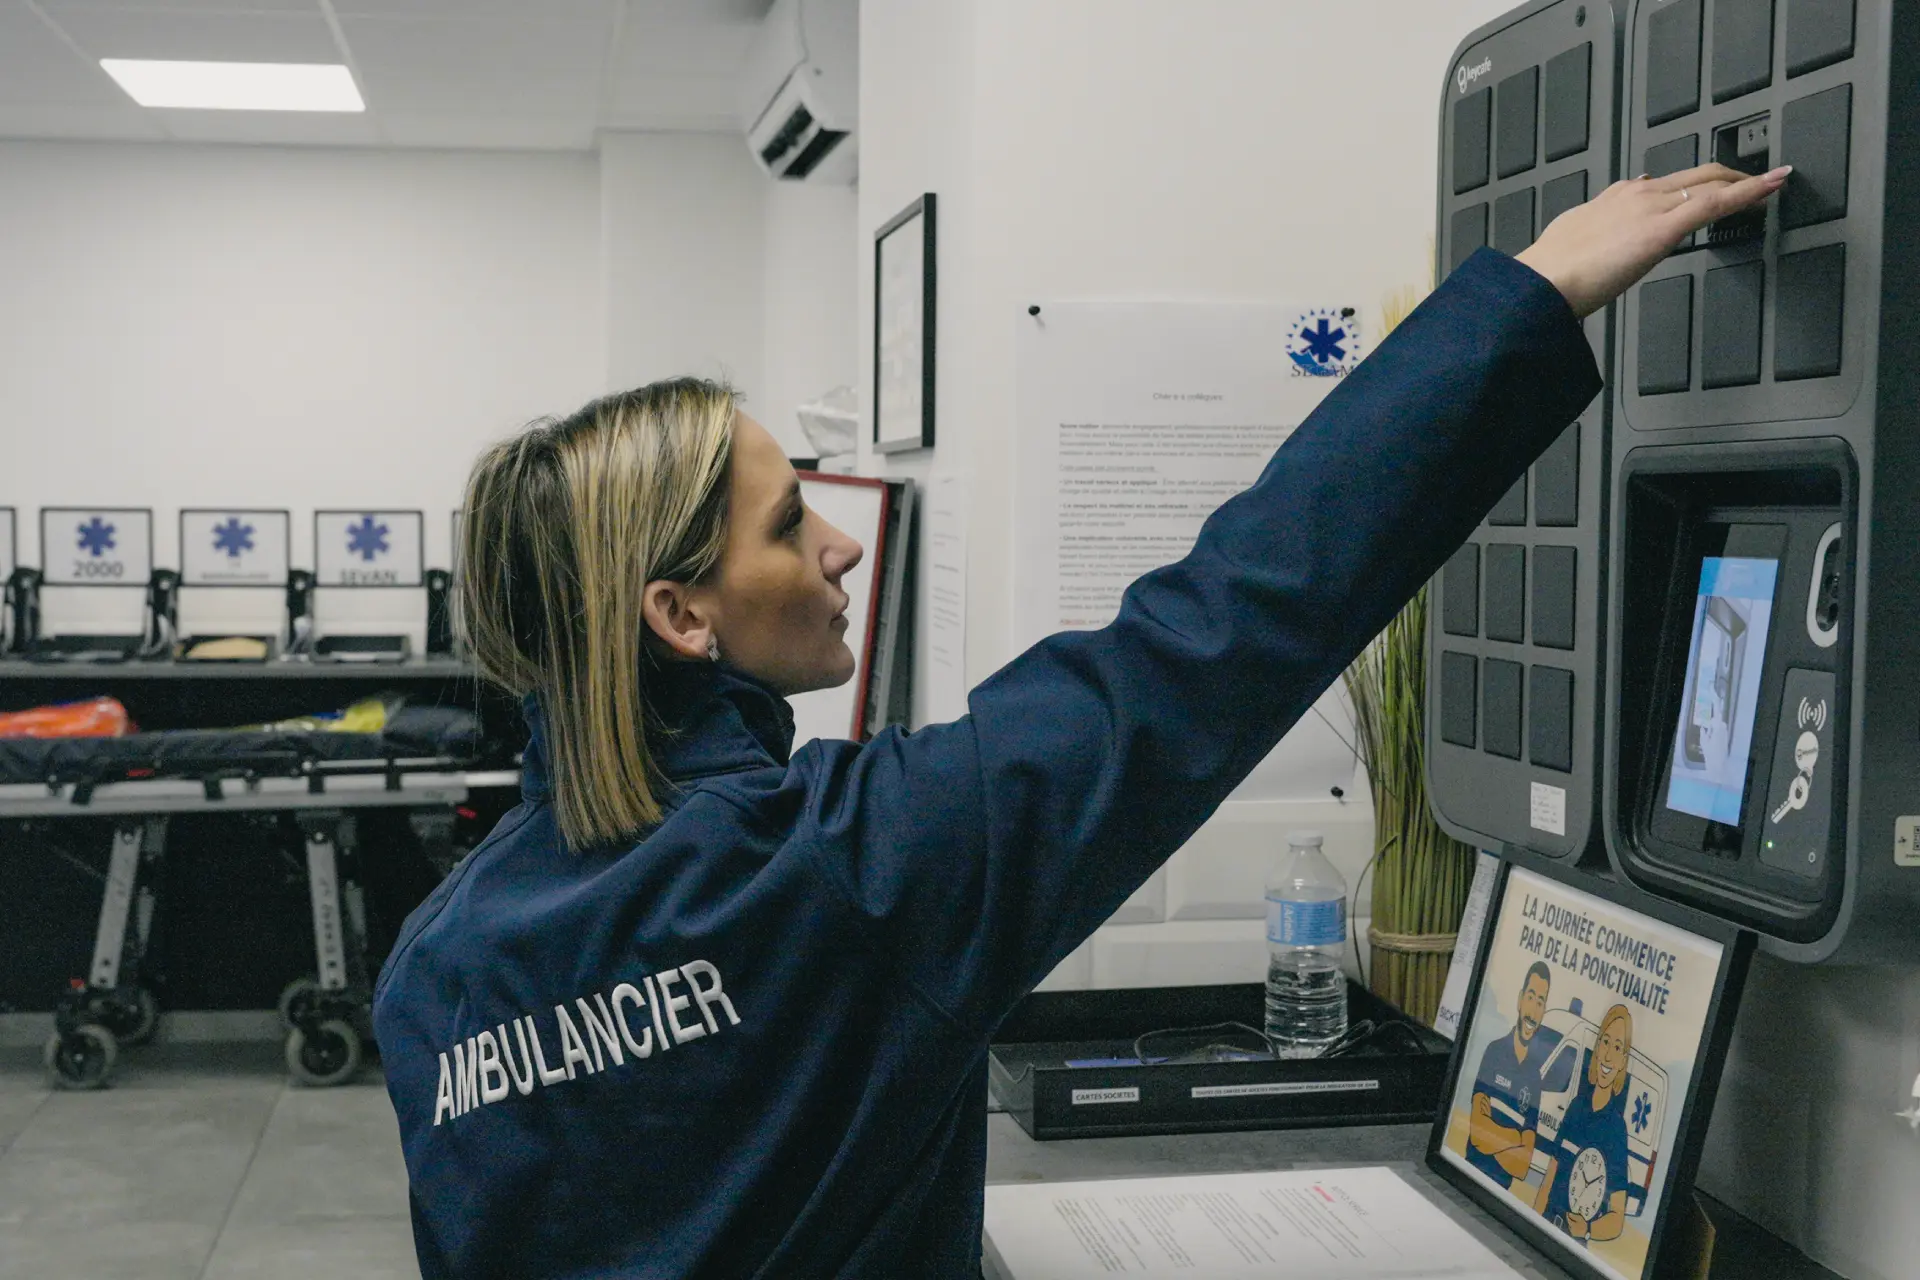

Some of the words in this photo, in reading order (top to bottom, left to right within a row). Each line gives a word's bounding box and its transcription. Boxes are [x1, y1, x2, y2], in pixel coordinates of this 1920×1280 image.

[1466, 56, 1492, 82] keycafe
[72, 560, 124, 579] 2000
[1522, 894, 1538, 920] LA
[1539, 902, 1595, 945] JOURNÉE
[1595, 925, 1676, 982] COMMENCE
[1519, 925, 1544, 955] PAR
[1544, 936, 1561, 963] DE
[1561, 944, 1578, 972] LA
[1580, 952, 1670, 1015] PONCTUALITÉ
[433, 959, 742, 1126] AMBULANCIER
[1075, 1093, 1102, 1101] CARTES
[1103, 1091, 1136, 1099] SOCIETES
